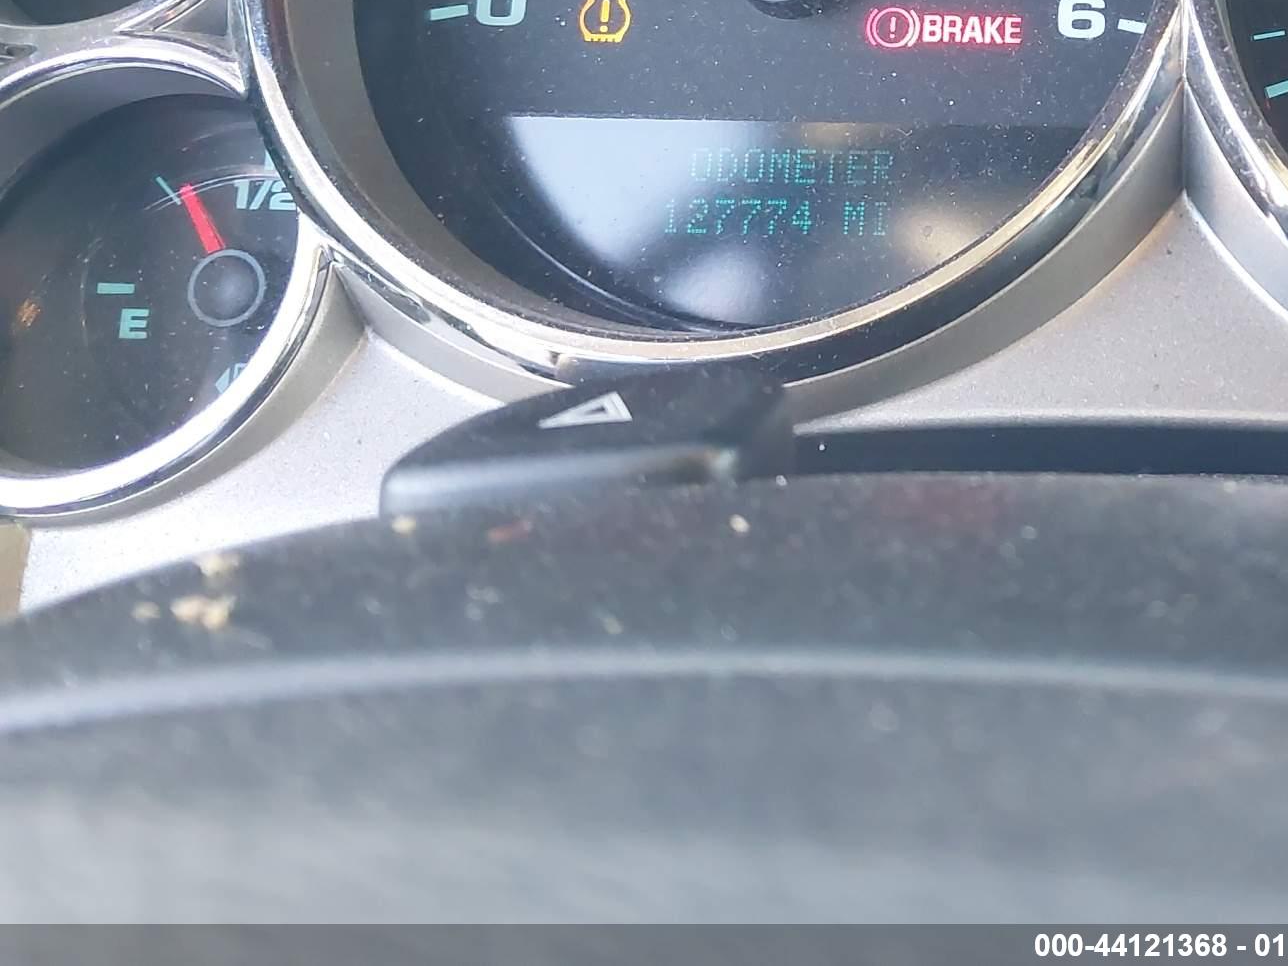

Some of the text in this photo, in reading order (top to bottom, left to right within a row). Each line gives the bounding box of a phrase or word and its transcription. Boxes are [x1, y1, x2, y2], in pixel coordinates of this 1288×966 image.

[922, 14, 1022, 44] BRAKE
[690, 149, 893, 183] ODOMETER
[234, 179, 296, 210] 1/2
[665, 199, 887, 236] 127774 MI
[118, 309, 149, 339] E
